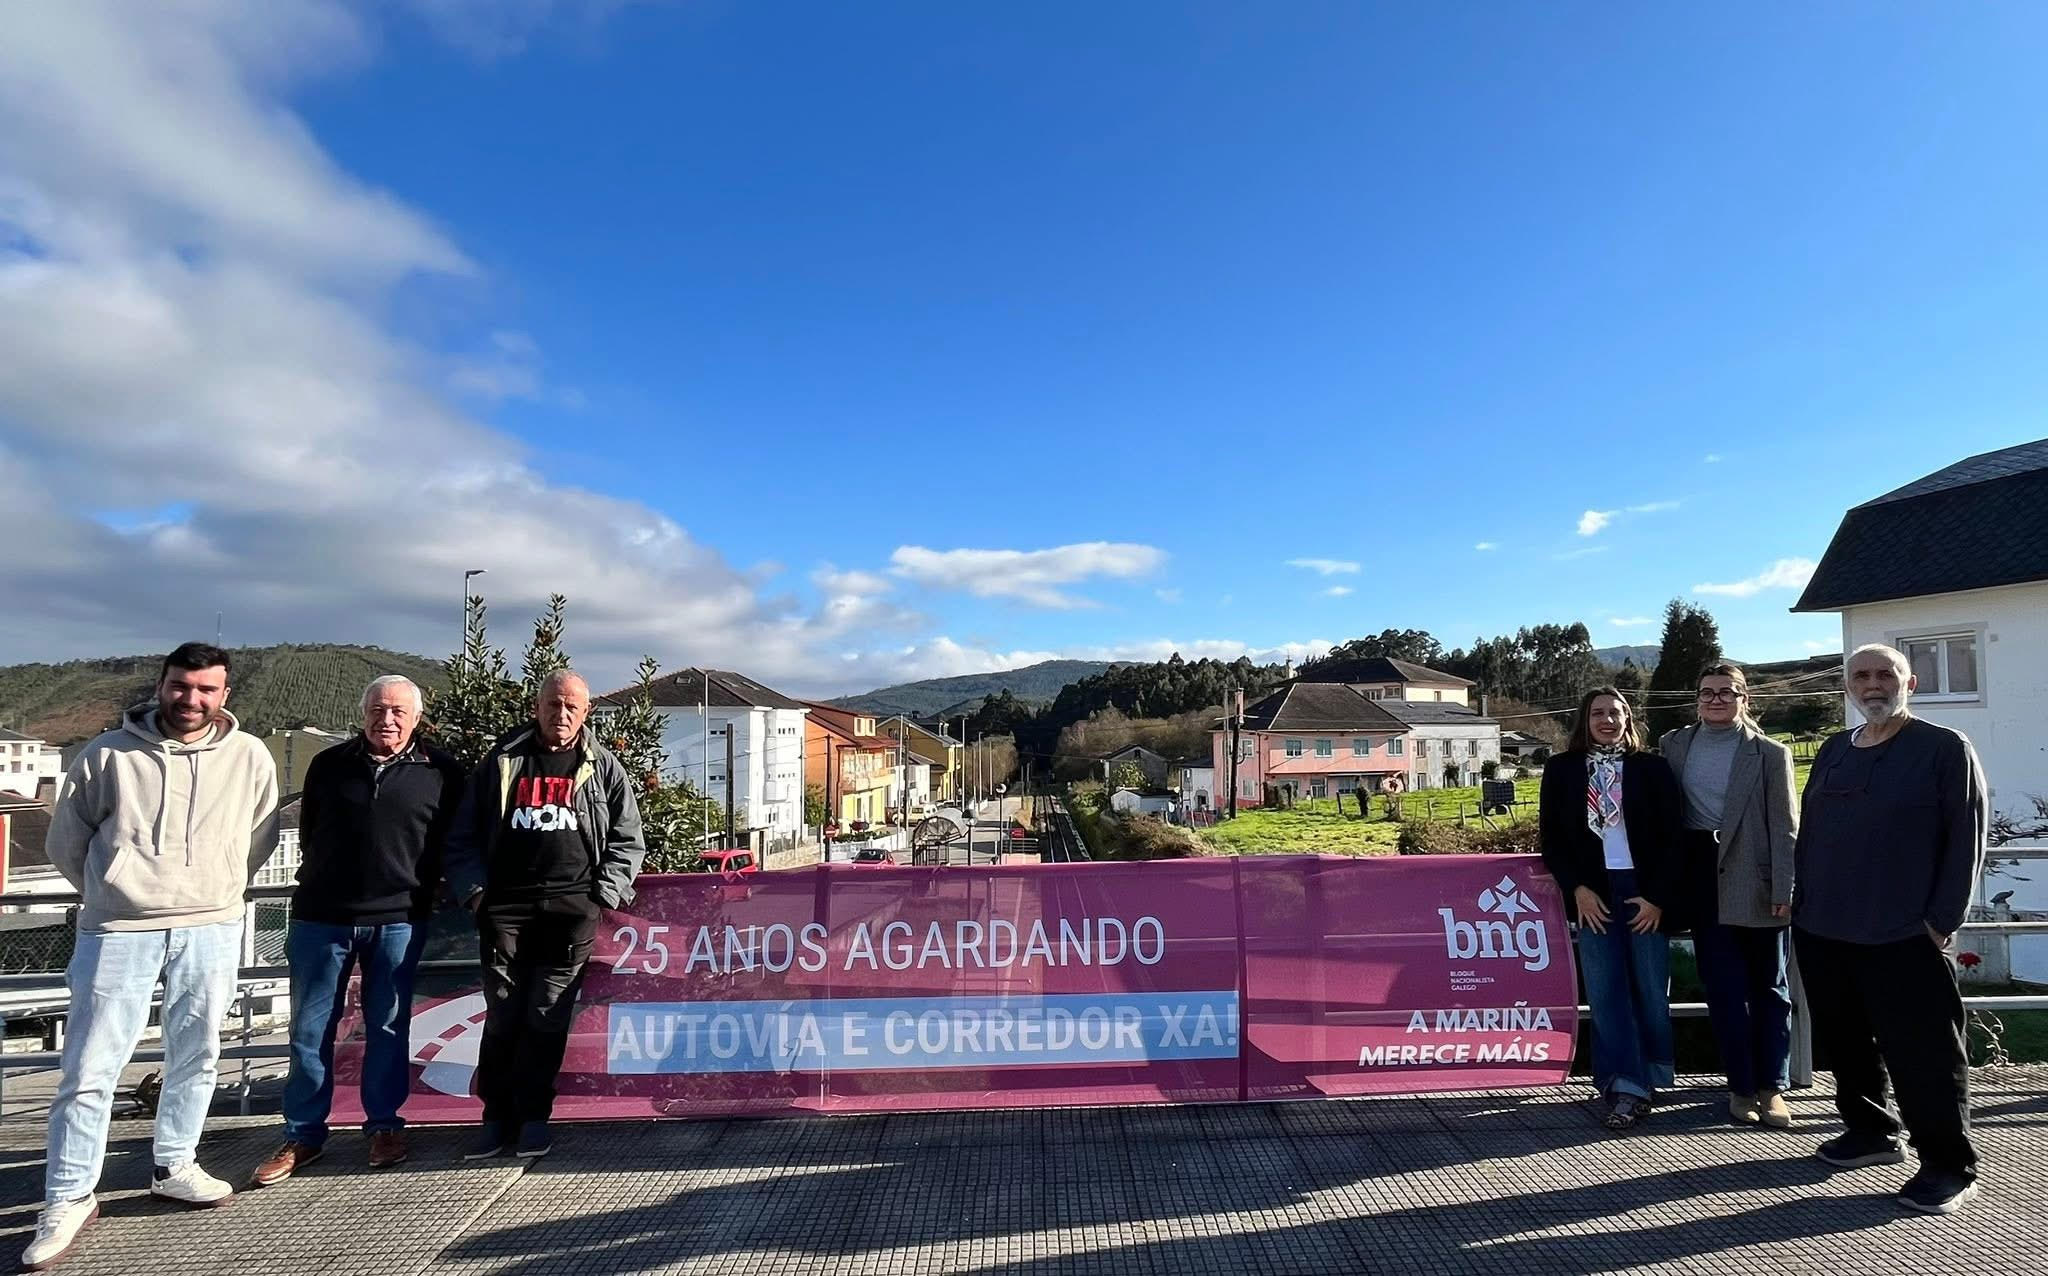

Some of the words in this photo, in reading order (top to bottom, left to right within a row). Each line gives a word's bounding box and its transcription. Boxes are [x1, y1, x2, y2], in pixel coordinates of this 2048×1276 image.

[611, 925, 670, 976] 25
[684, 922, 828, 974] ANOS
[843, 916, 1165, 971] AGARDANDO
[1438, 907, 1550, 971] bng
[608, 1000, 827, 1061] AUTOVÍA
[842, 1011, 869, 1056] E
[884, 1005, 1144, 1055] CORREDOR
[1157, 1003, 1238, 1048] XA!
[1406, 1009, 1429, 1034] A
[1435, 1000, 1554, 1033] MARIÑA
[1358, 1044, 1471, 1067] MERECE
[1475, 1036, 1550, 1063] MÁIS
